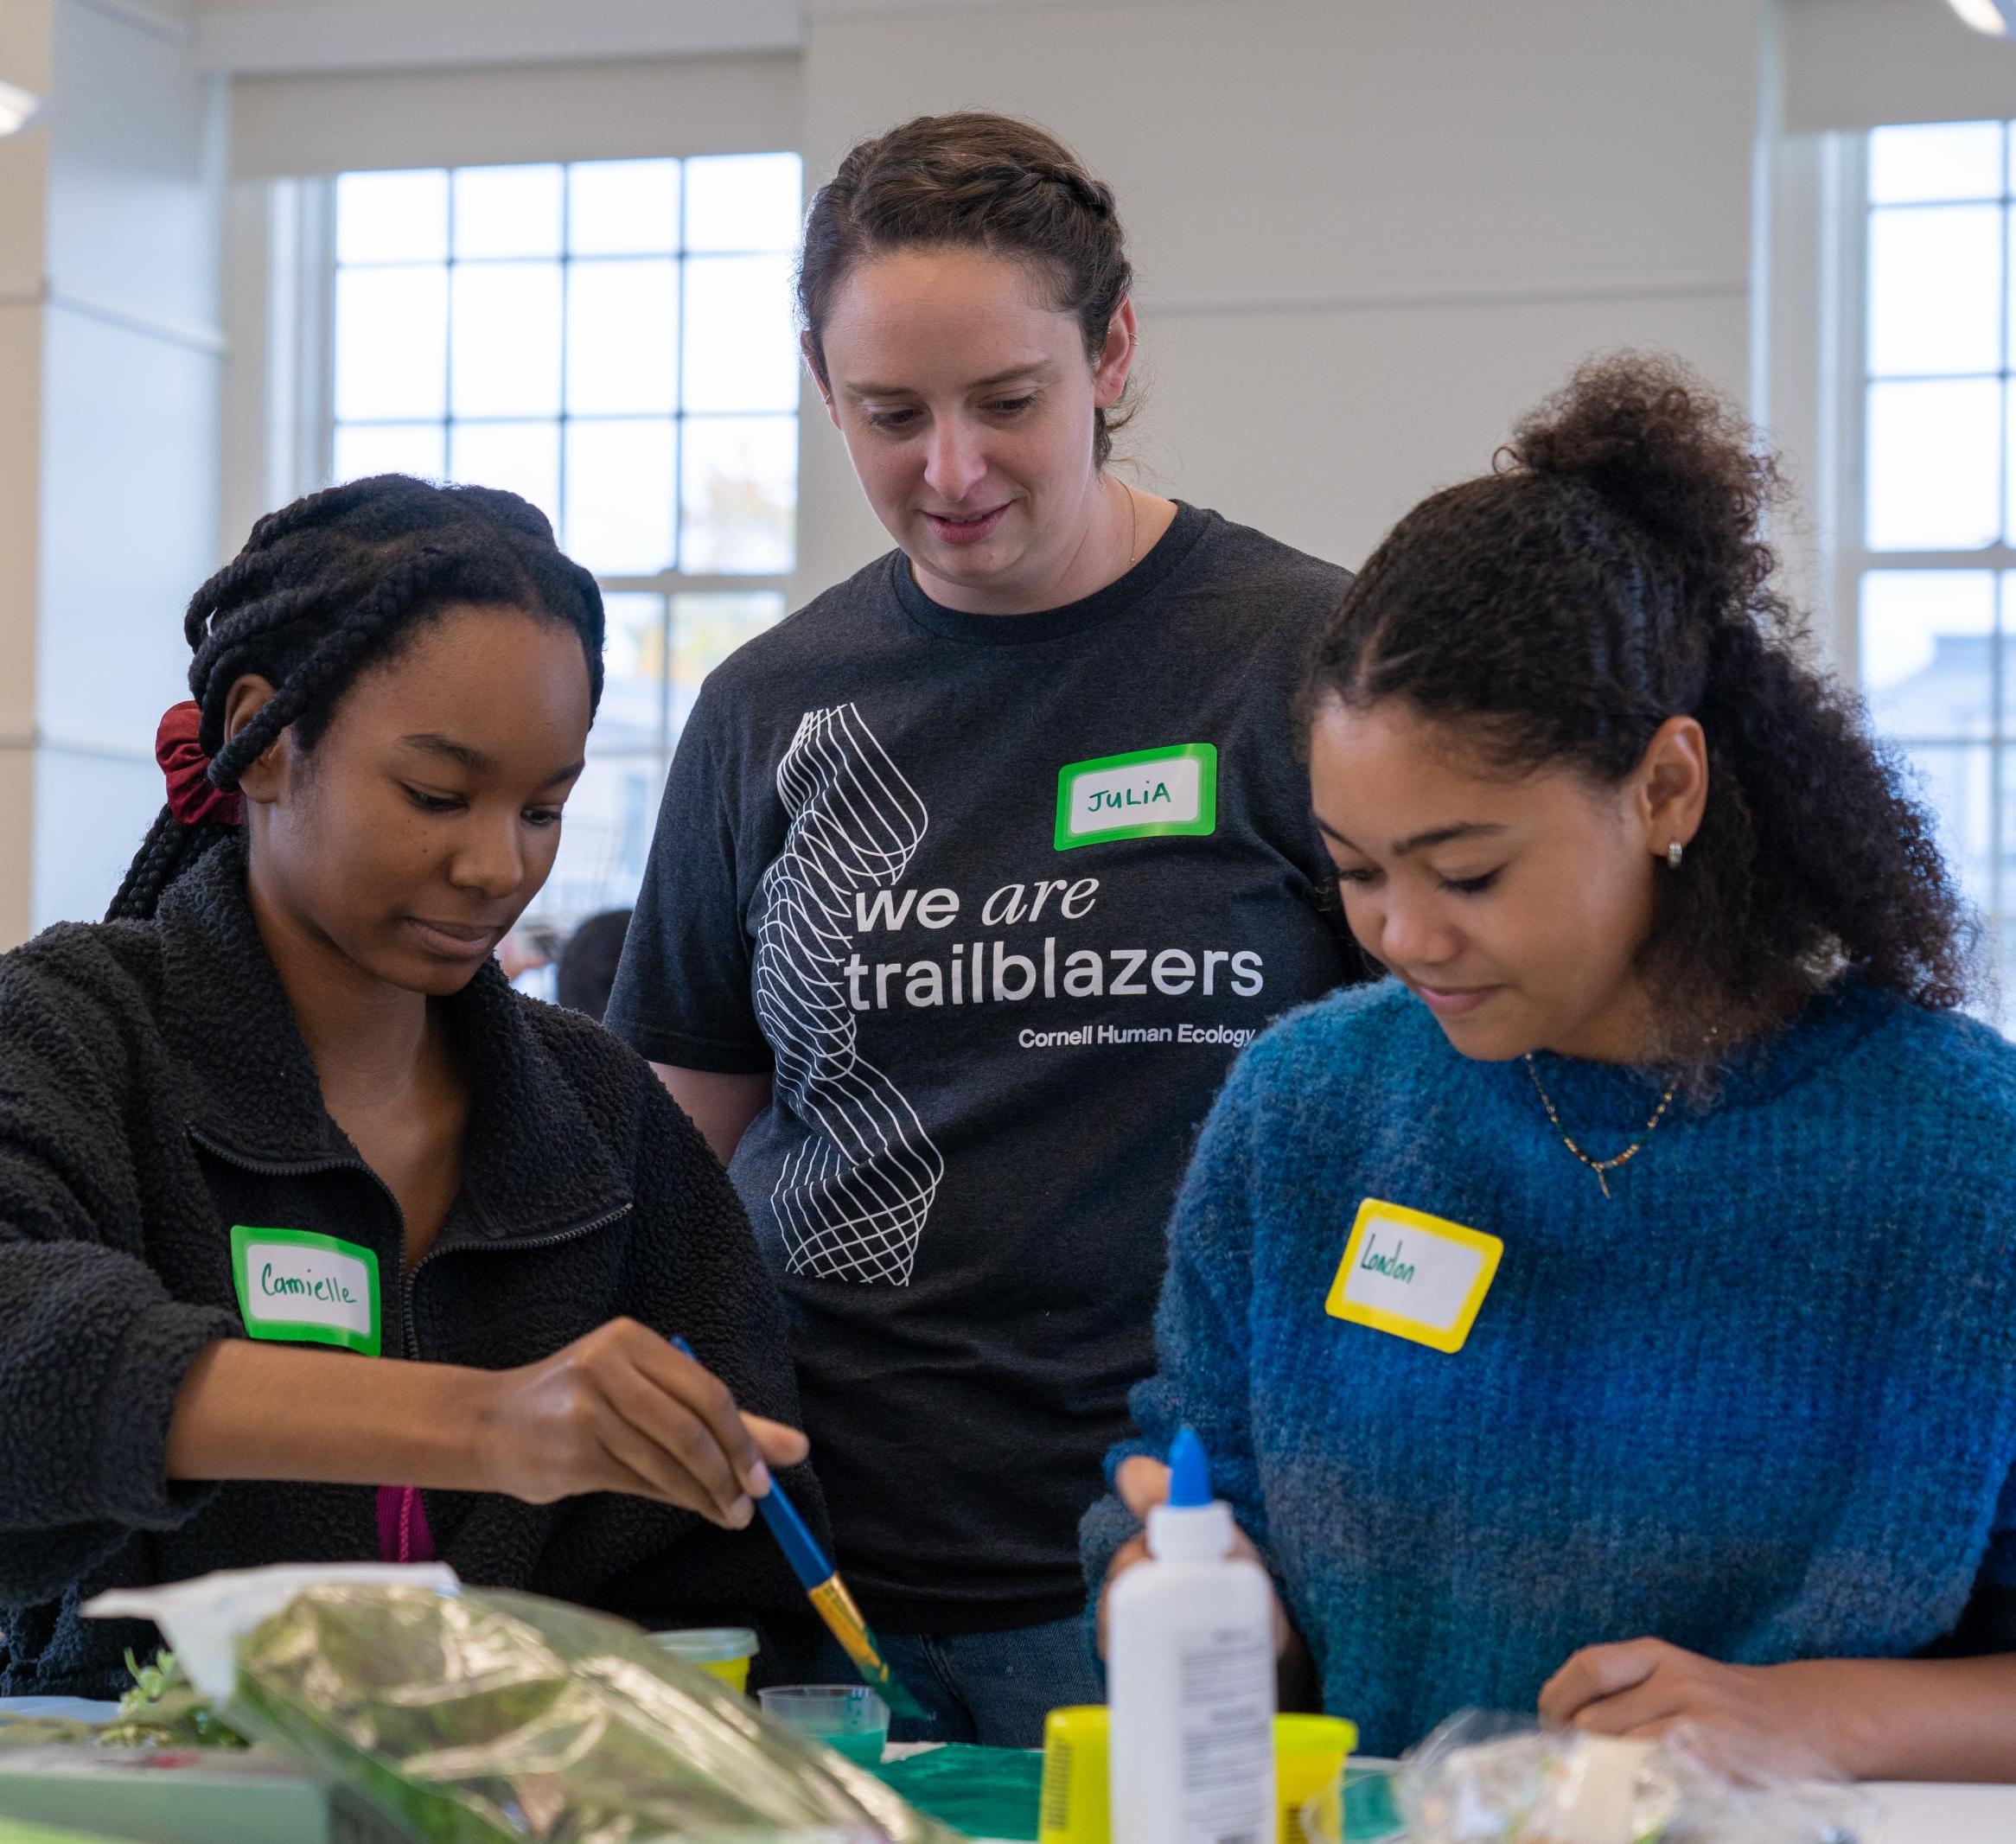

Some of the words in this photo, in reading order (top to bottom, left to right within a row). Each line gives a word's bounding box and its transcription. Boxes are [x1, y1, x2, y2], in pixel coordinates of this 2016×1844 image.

[856, 888, 960, 933] we
[981, 877, 1100, 926] are
[844, 936, 1264, 1011] trailblazers
[1018, 1025, 1093, 1048] Cornell
[1097, 1024, 1171, 1043] Human
[1177, 1024, 1255, 1048] Ecology
[262, 1262, 356, 1303] Camielle
[1361, 1233, 1415, 1284] London
